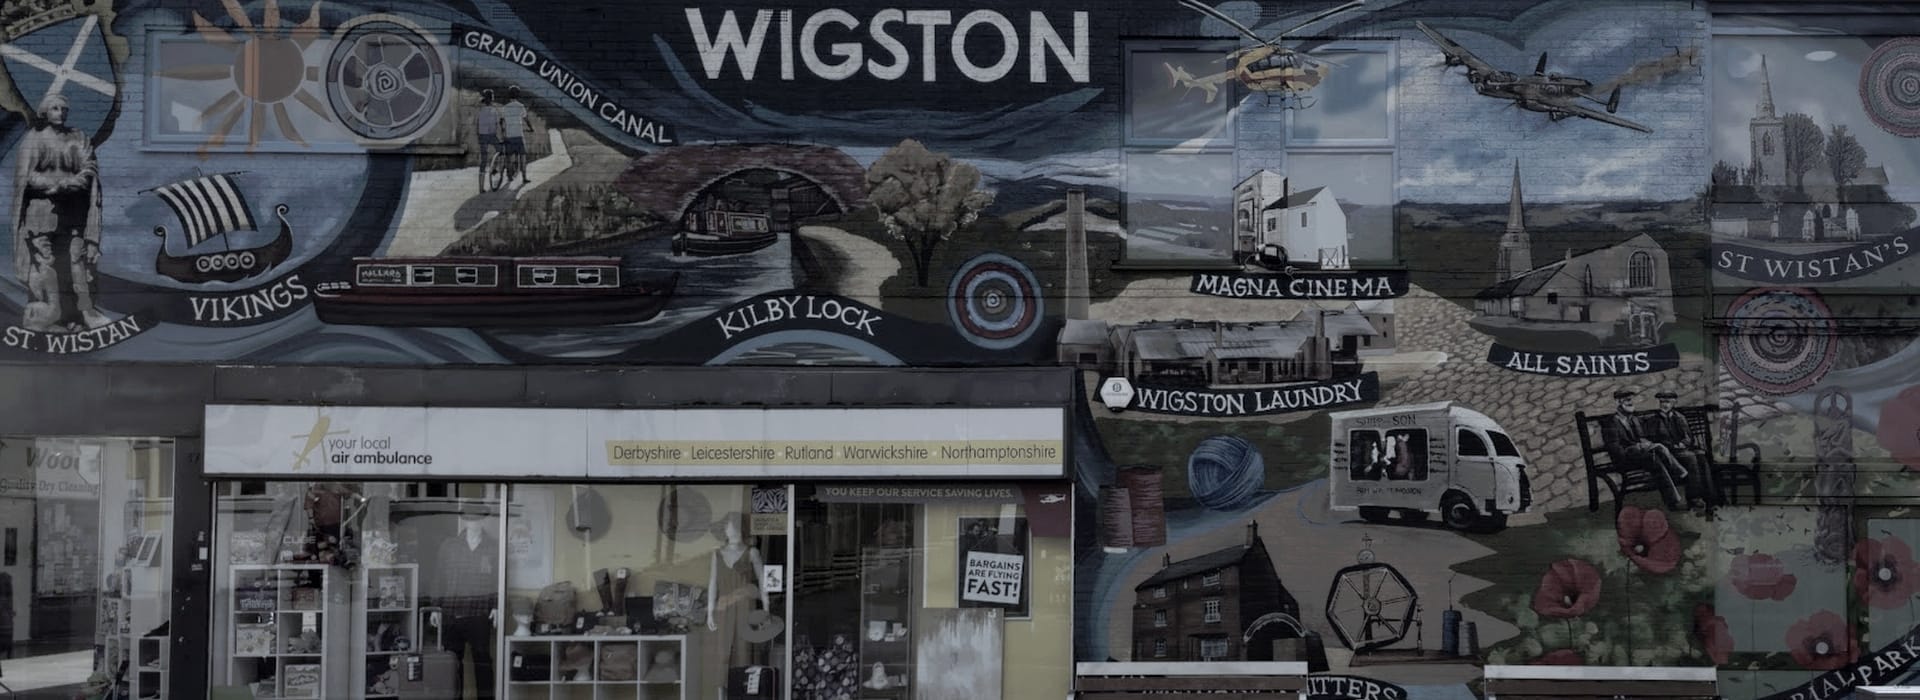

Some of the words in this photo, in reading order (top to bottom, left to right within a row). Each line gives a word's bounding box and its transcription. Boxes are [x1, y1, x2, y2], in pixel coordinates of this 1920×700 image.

[684, 7, 1091, 84] WIGSTON
[463, 30, 539, 74] GRAND
[538, 63, 597, 109] UNION
[598, 100, 674, 145] CANAL
[1717, 250, 1753, 274] ST
[1766, 236, 1910, 279] WISTAN'S
[1196, 274, 1281, 298] MAGNA
[1289, 277, 1394, 297] CINEMA
[190, 275, 308, 322] VIKINGS
[716, 295, 802, 340] KILBY
[806, 296, 882, 336] LOCK
[3, 325, 38, 350] ST.
[46, 315, 140, 354] WISTAN
[1506, 351, 1549, 372] ALL
[1556, 352, 1650, 375] SAINTS
[1137, 388, 1245, 415] WIGSTON
[1255, 379, 1364, 412] LAUNDRY
[329, 437, 357, 451] your
[361, 436, 391, 450] local
[613, 445, 681, 464] Derbyshire
[691, 445, 775, 461] Leicestershire
[785, 445, 833, 460] Rutland
[843, 445, 928, 460] Warwickshire
[941, 444, 1056, 464] Northamptonshire
[331, 452, 350, 464] air
[354, 451, 433, 464] ambulance
[825, 487, 847, 497] YOU
[849, 488, 875, 497] KEEP
[876, 488, 899, 497] OUR
[901, 488, 943, 497] SERVICE
[945, 488, 982, 498] SAVING
[984, 488, 1013, 498] LIVES.
[968, 570, 986, 578] ARE
[988, 570, 1020, 580] FLYING
[969, 559, 1021, 571] BARGAINS
[968, 580, 1018, 597] FAST!
